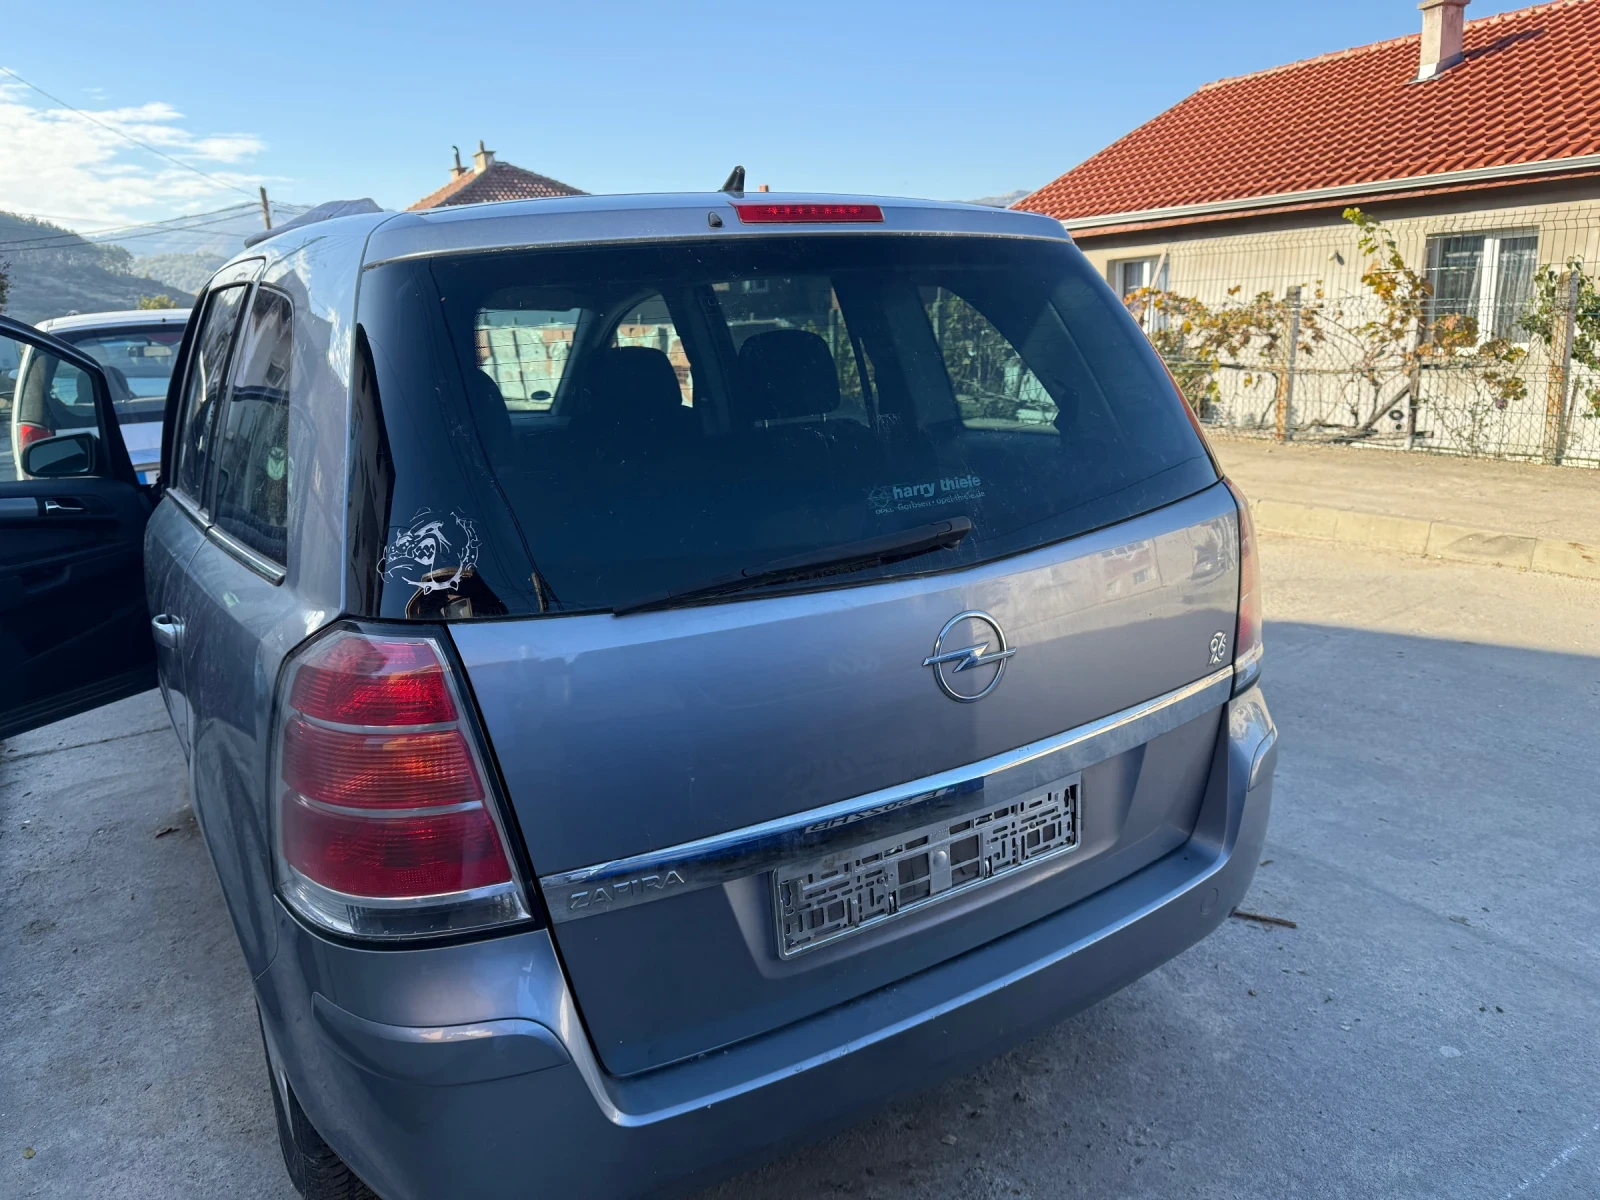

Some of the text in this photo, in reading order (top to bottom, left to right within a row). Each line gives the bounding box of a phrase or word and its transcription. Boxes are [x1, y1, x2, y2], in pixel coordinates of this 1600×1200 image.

[892, 474, 981, 499] harry thiele
[569, 870, 685, 911] ZAFIRA
